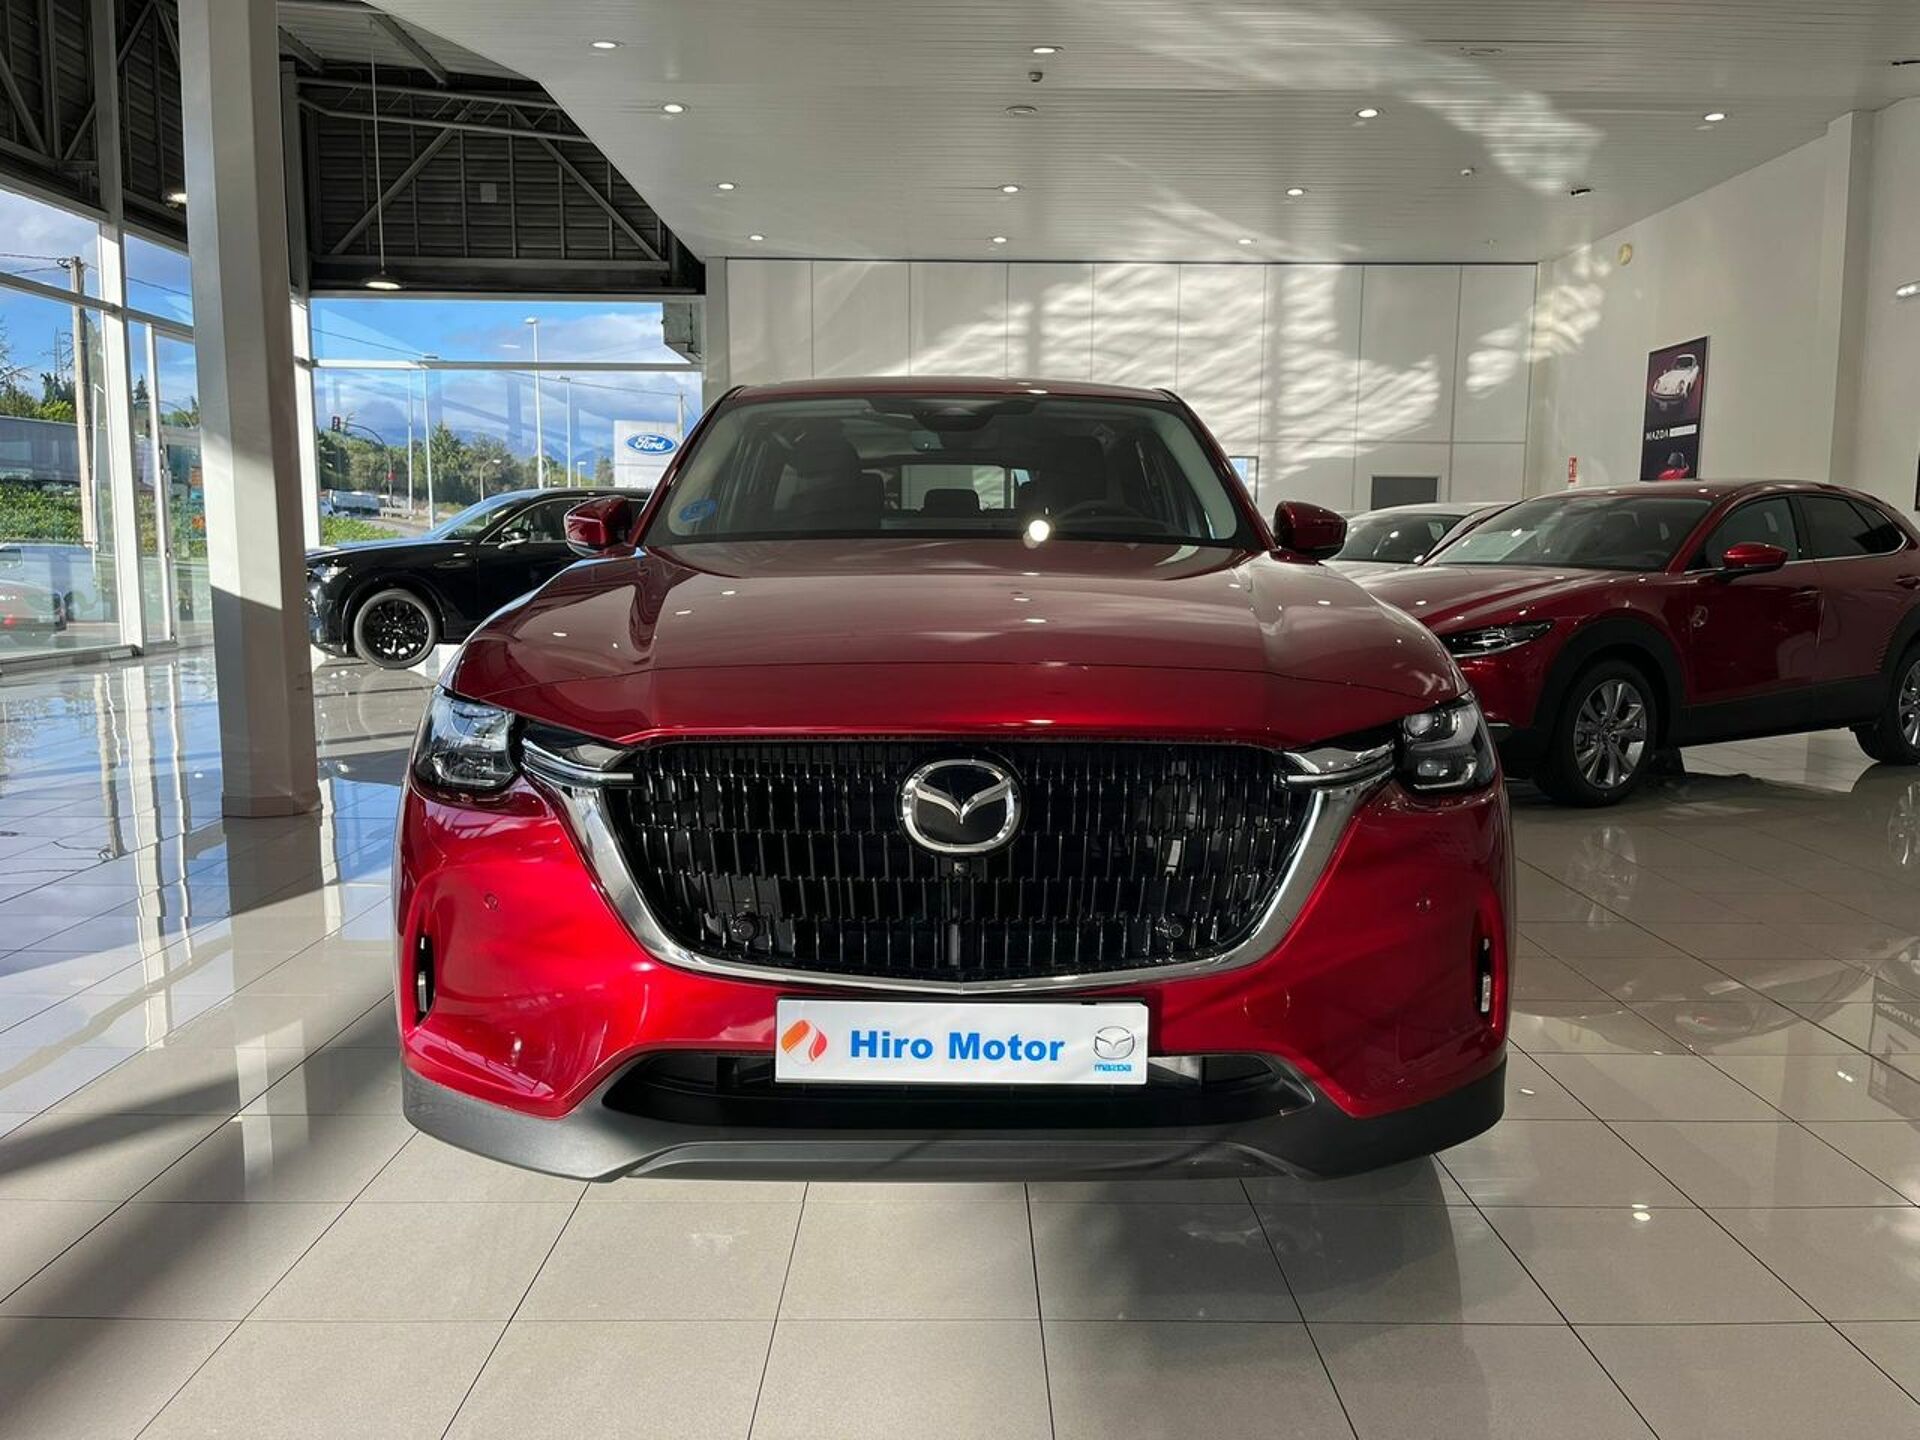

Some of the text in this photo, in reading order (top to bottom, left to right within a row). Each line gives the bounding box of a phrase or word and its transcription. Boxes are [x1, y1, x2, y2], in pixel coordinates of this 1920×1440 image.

[634, 434, 666, 450] Ford
[850, 1030, 1066, 1062] Hiro Motor
